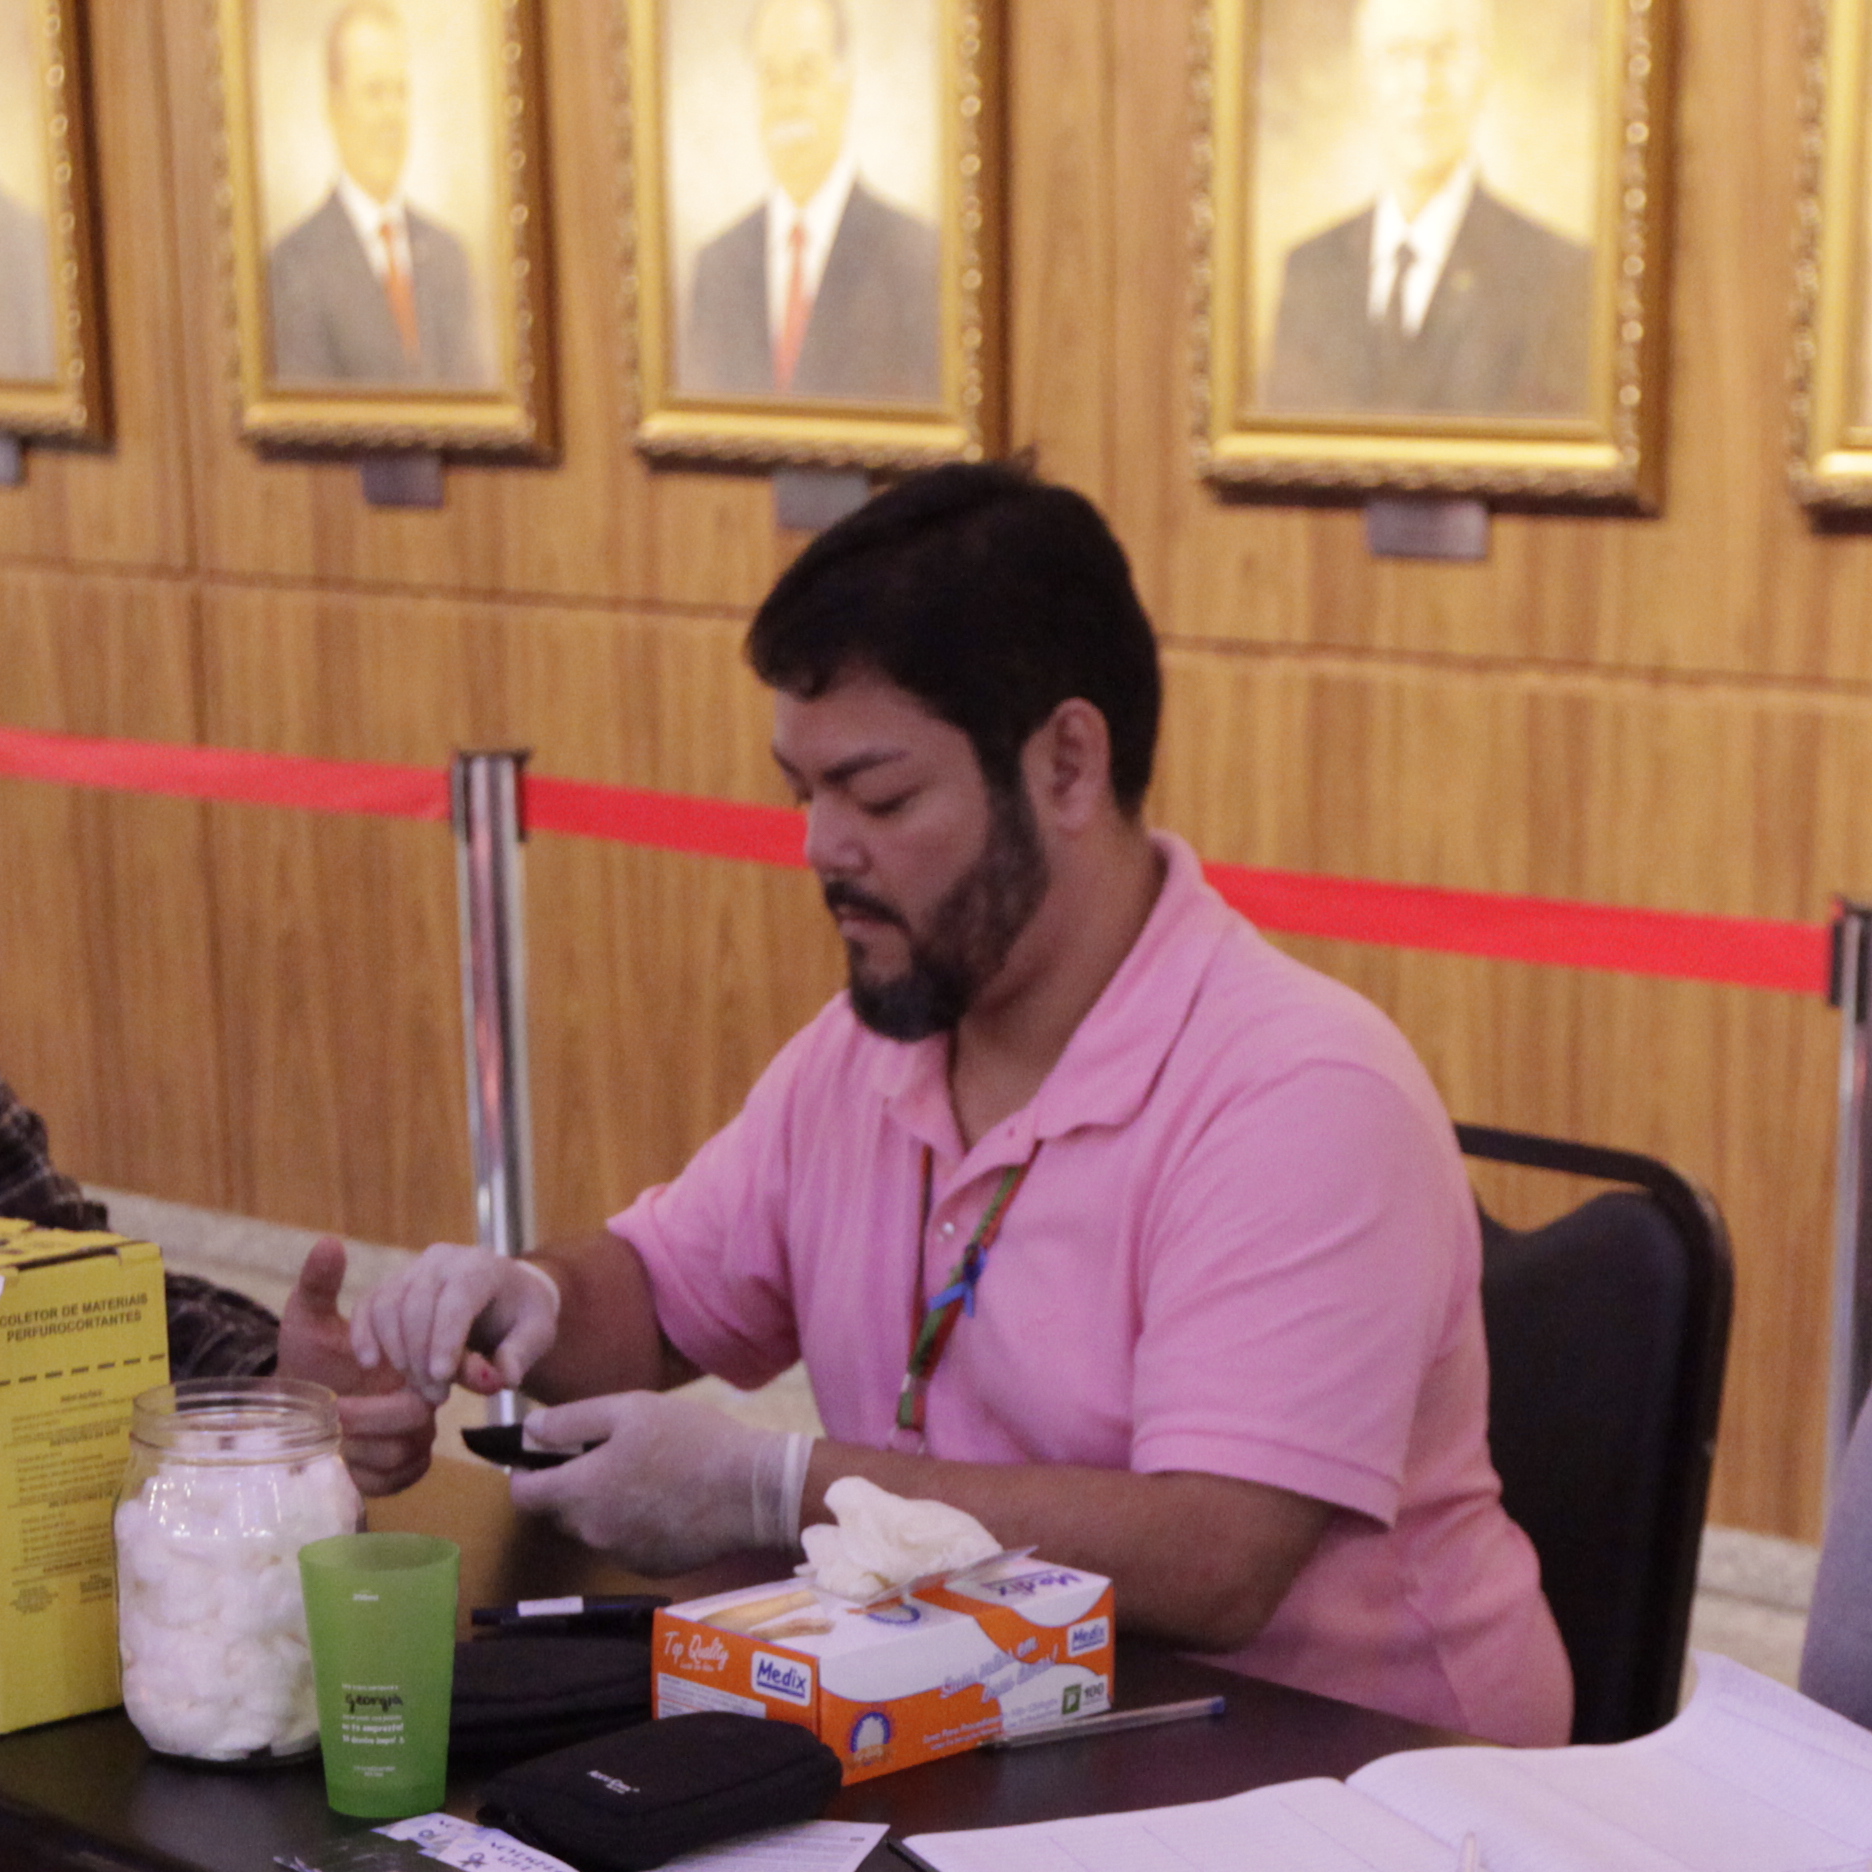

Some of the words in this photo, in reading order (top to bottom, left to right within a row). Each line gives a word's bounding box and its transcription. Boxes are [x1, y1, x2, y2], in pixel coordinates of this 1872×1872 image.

[0, 1307, 58, 1328] COLETOR
[61, 1303, 78, 1318] DE
[82, 1292, 148, 1315] MATERIAIS
[6, 1310, 142, 1342] PERFUROCORTANTES
[1073, 1624, 1105, 1645] Medix
[665, 1631, 685, 1664] Top
[689, 1634, 729, 1672] Quality
[757, 1659, 806, 1692] Medix
[1084, 1682, 1105, 1699] 100
